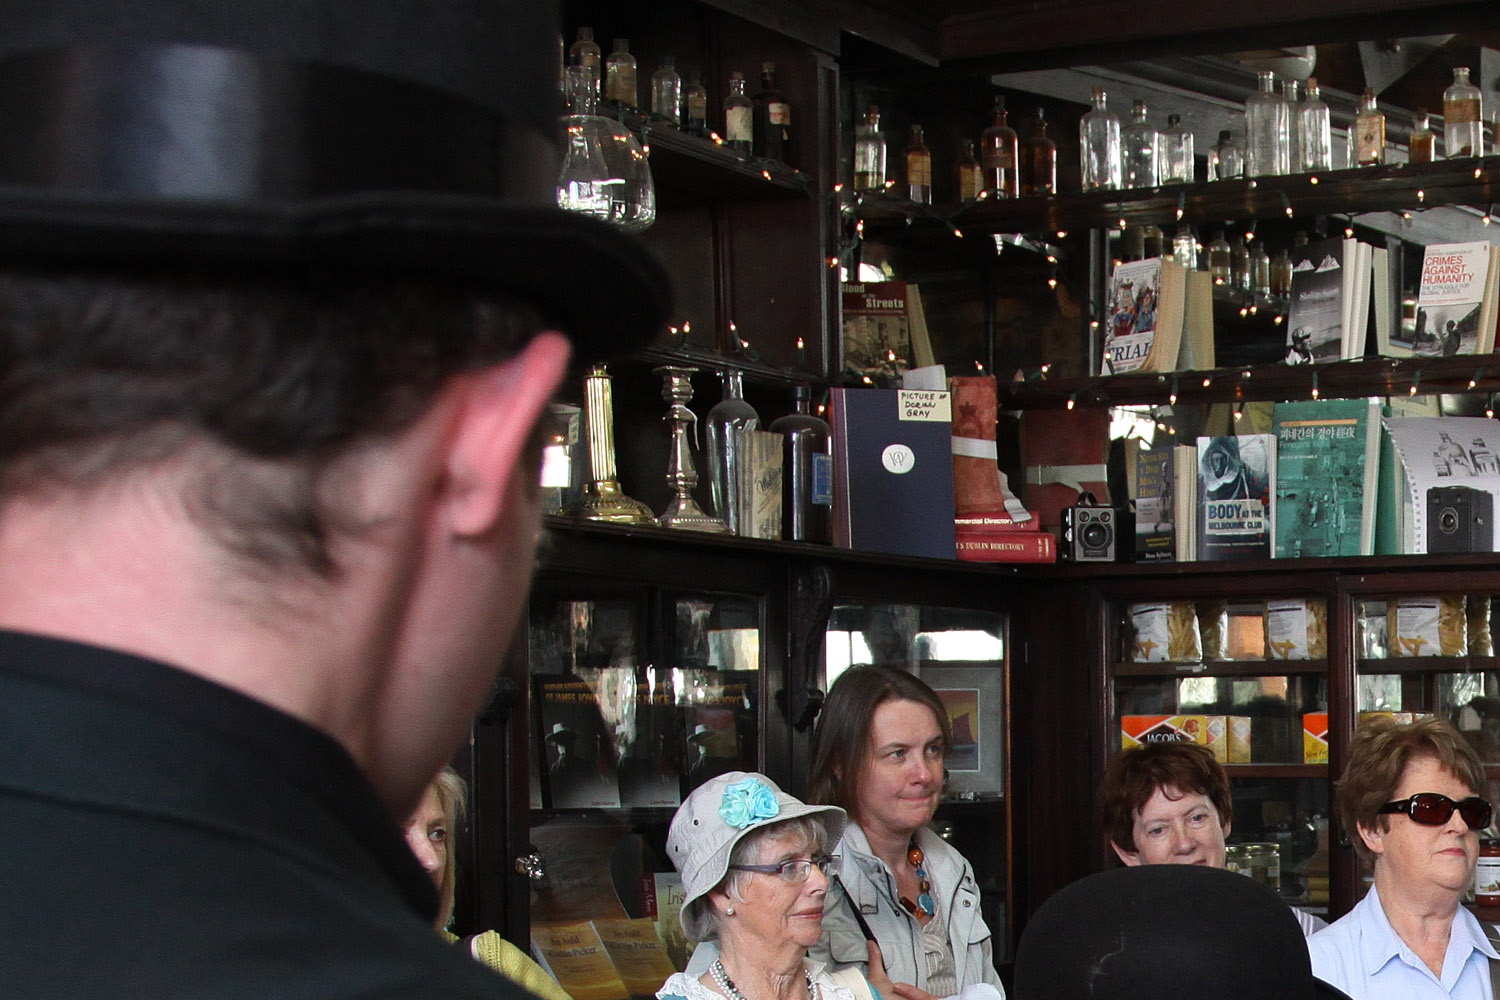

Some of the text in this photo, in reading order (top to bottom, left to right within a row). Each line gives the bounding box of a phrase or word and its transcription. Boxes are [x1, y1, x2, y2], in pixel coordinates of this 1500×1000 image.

[1425, 255, 1463, 266] CRIMES
[1424, 264, 1466, 276] AGAINST
[1423, 273, 1474, 284] HUMANITY
[866, 298, 904, 308] Streets
[901, 392, 925, 400] PICTURE
[906, 409, 930, 418] GRAY
[1208, 503, 1263, 519] BODY AT THE
[1247, 521, 1263, 529] CLUB
[1147, 733, 1181, 742] JACOB'S
